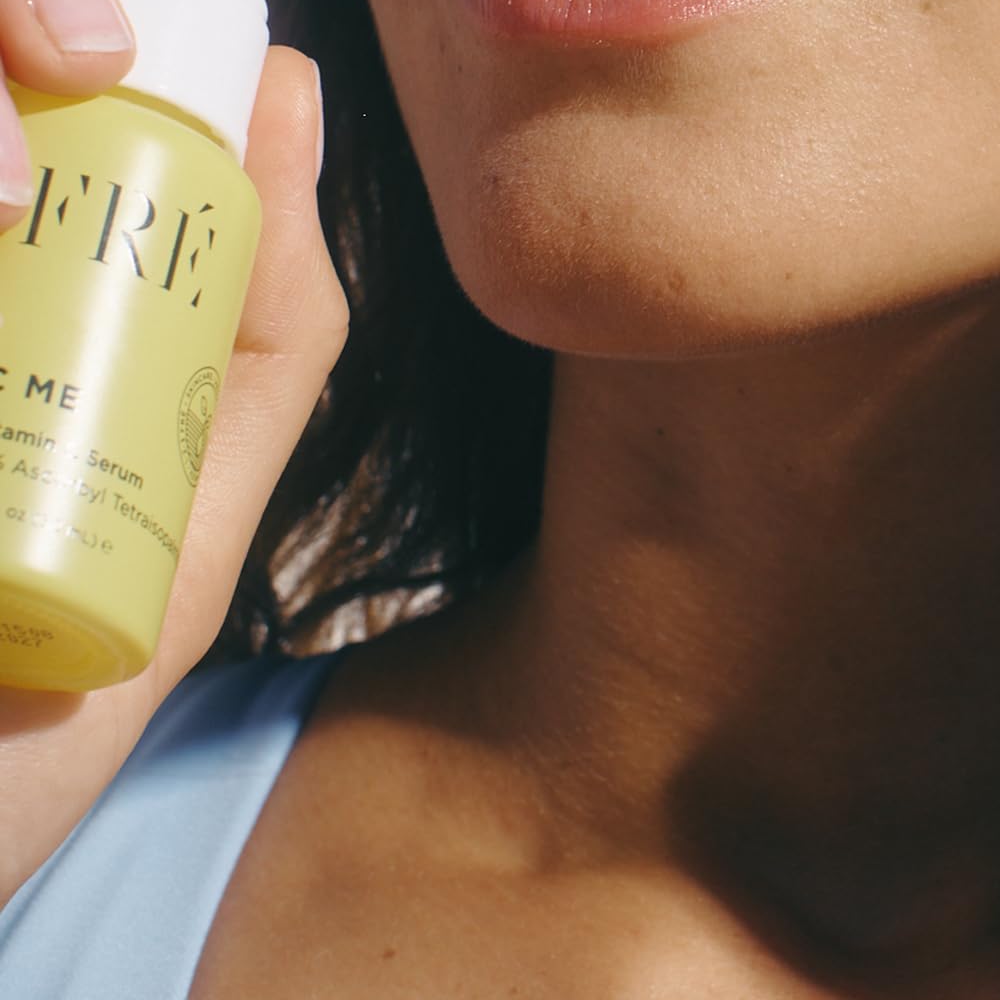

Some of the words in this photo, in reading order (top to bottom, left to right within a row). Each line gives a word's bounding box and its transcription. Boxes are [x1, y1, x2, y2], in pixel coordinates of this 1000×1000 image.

[19, 165, 215, 308] FRÉ
[24, 373, 80, 411] ME
[0, 424, 56, 451] amin
[87, 449, 145, 491] Serum
